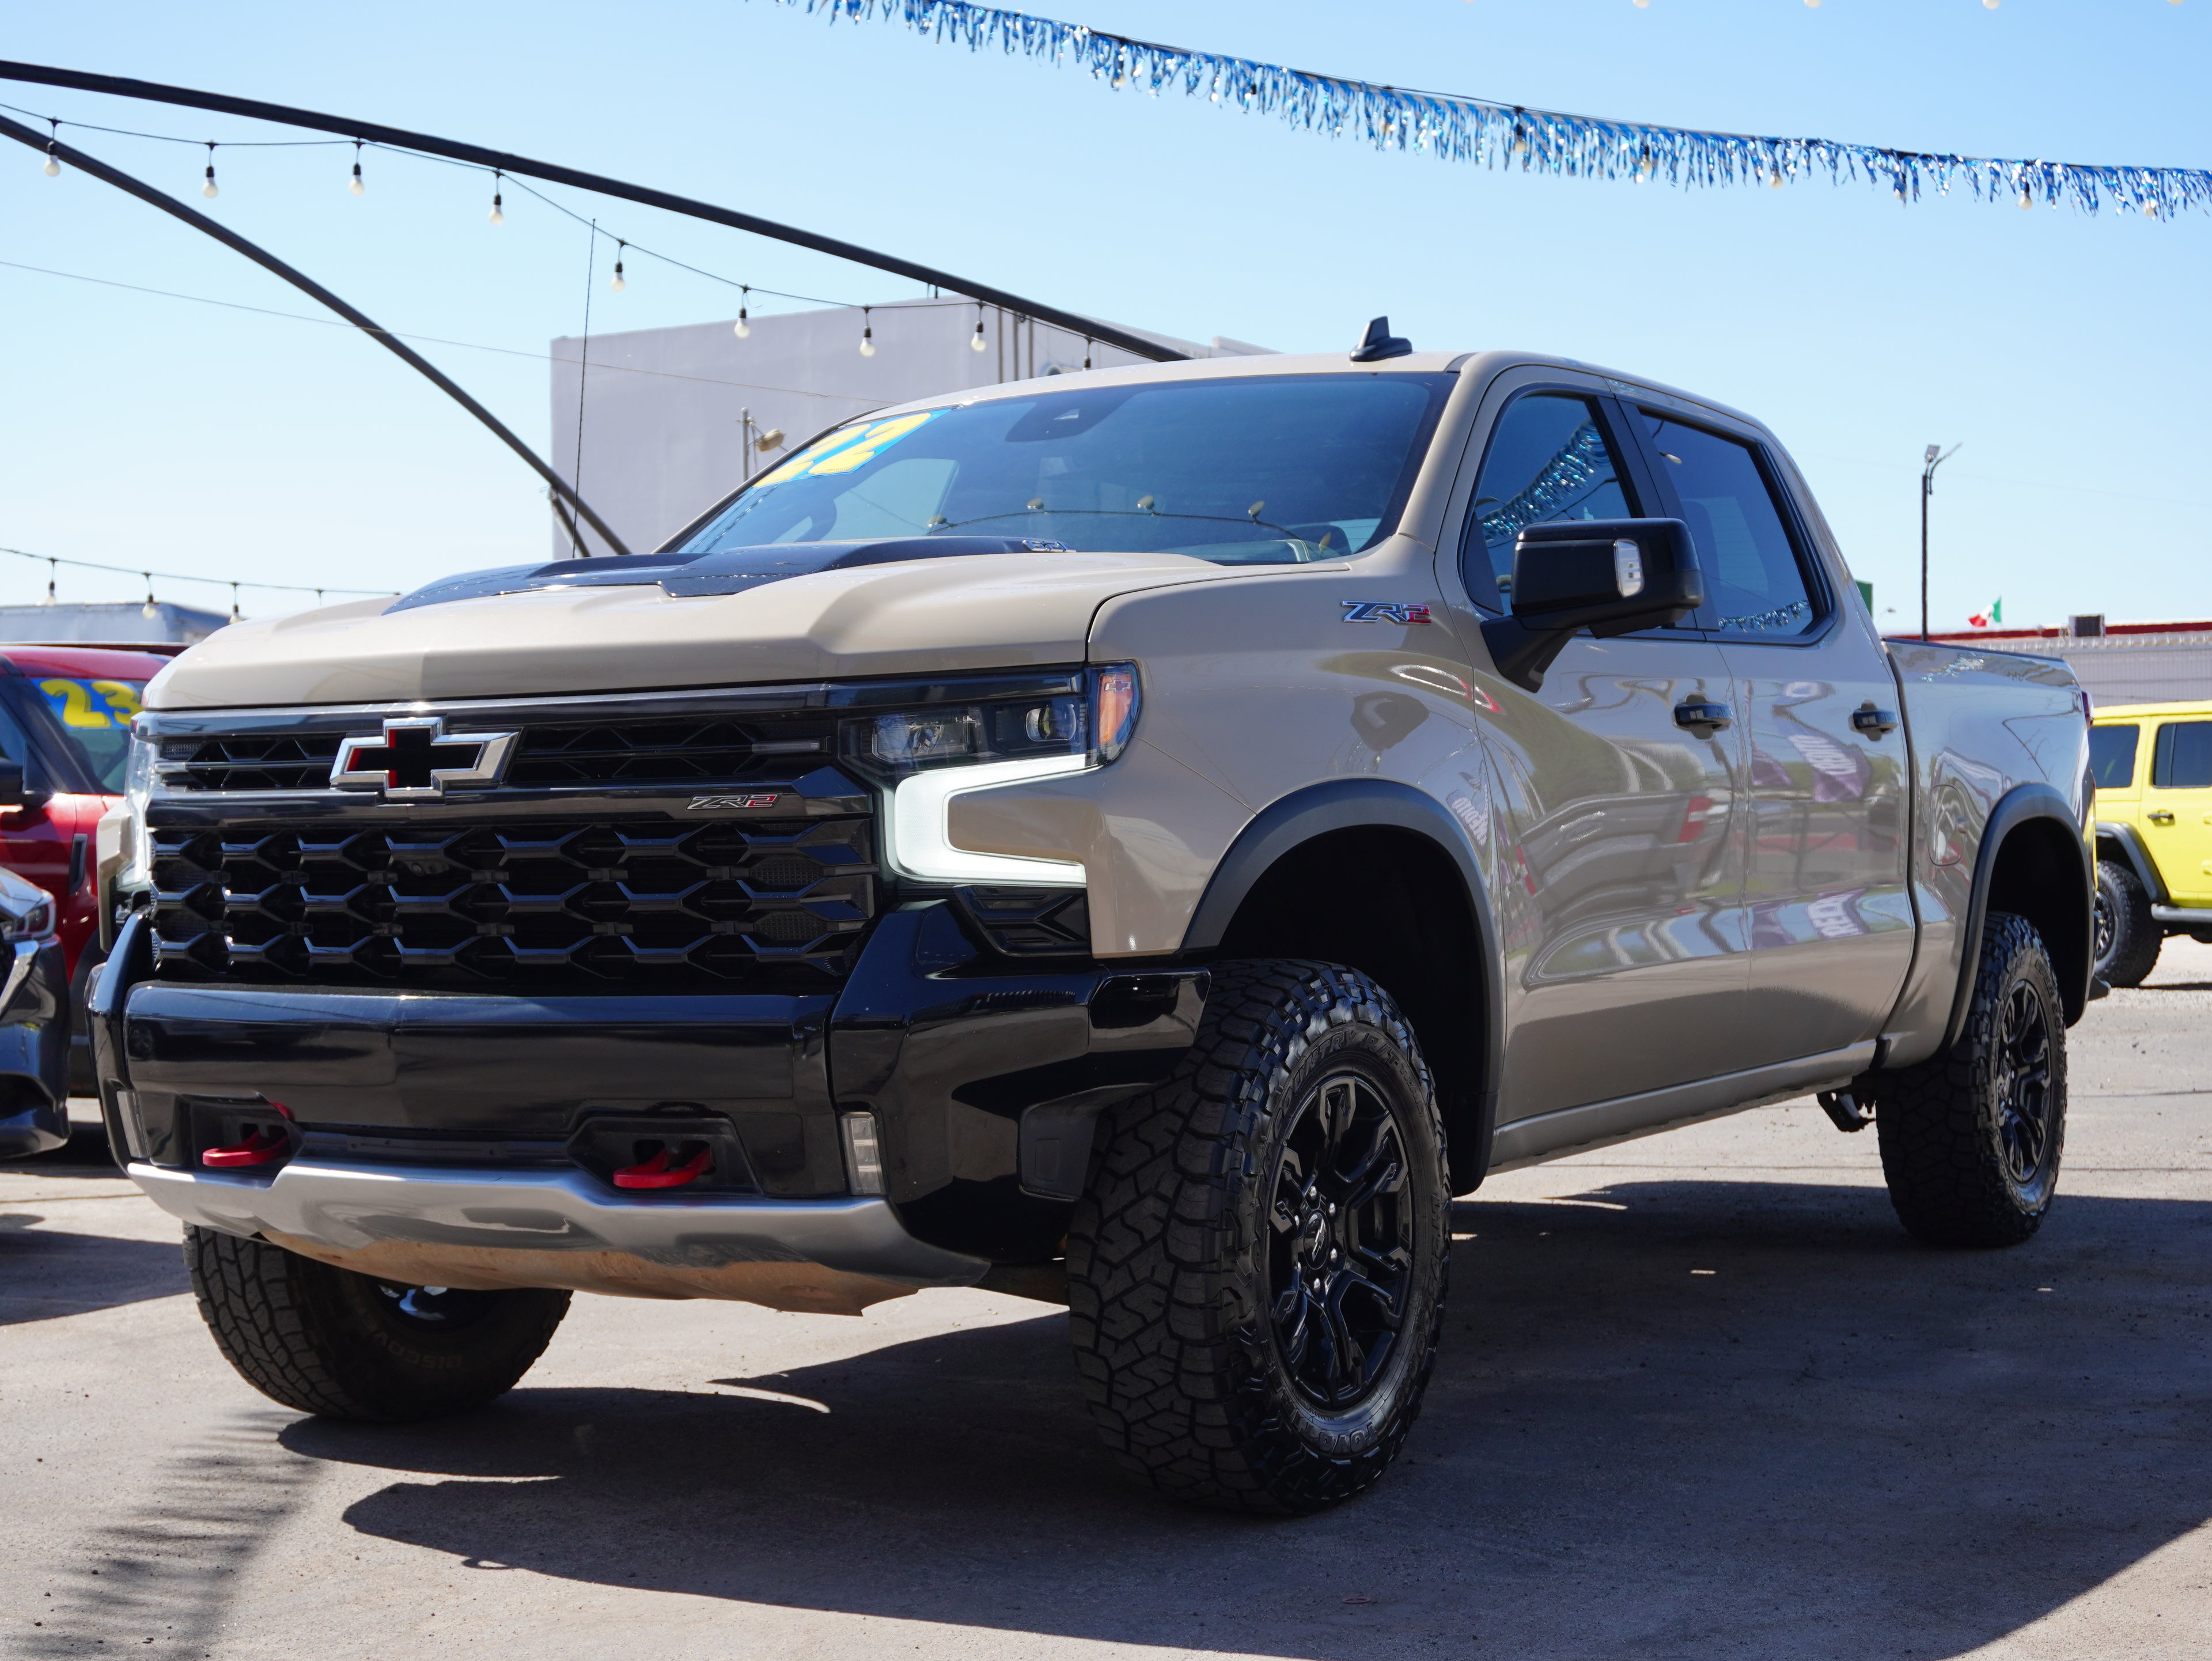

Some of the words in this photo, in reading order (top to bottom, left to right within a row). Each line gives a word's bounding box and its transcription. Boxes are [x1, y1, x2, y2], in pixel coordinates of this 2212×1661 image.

[1341, 600, 1432, 626] ZR2
[40, 679, 143, 729] 23
[686, 793, 779, 810] ZR2
[1274, 1030, 1358, 1140] COUNTRY
[1318, 1421, 1379, 1454] TOYO
